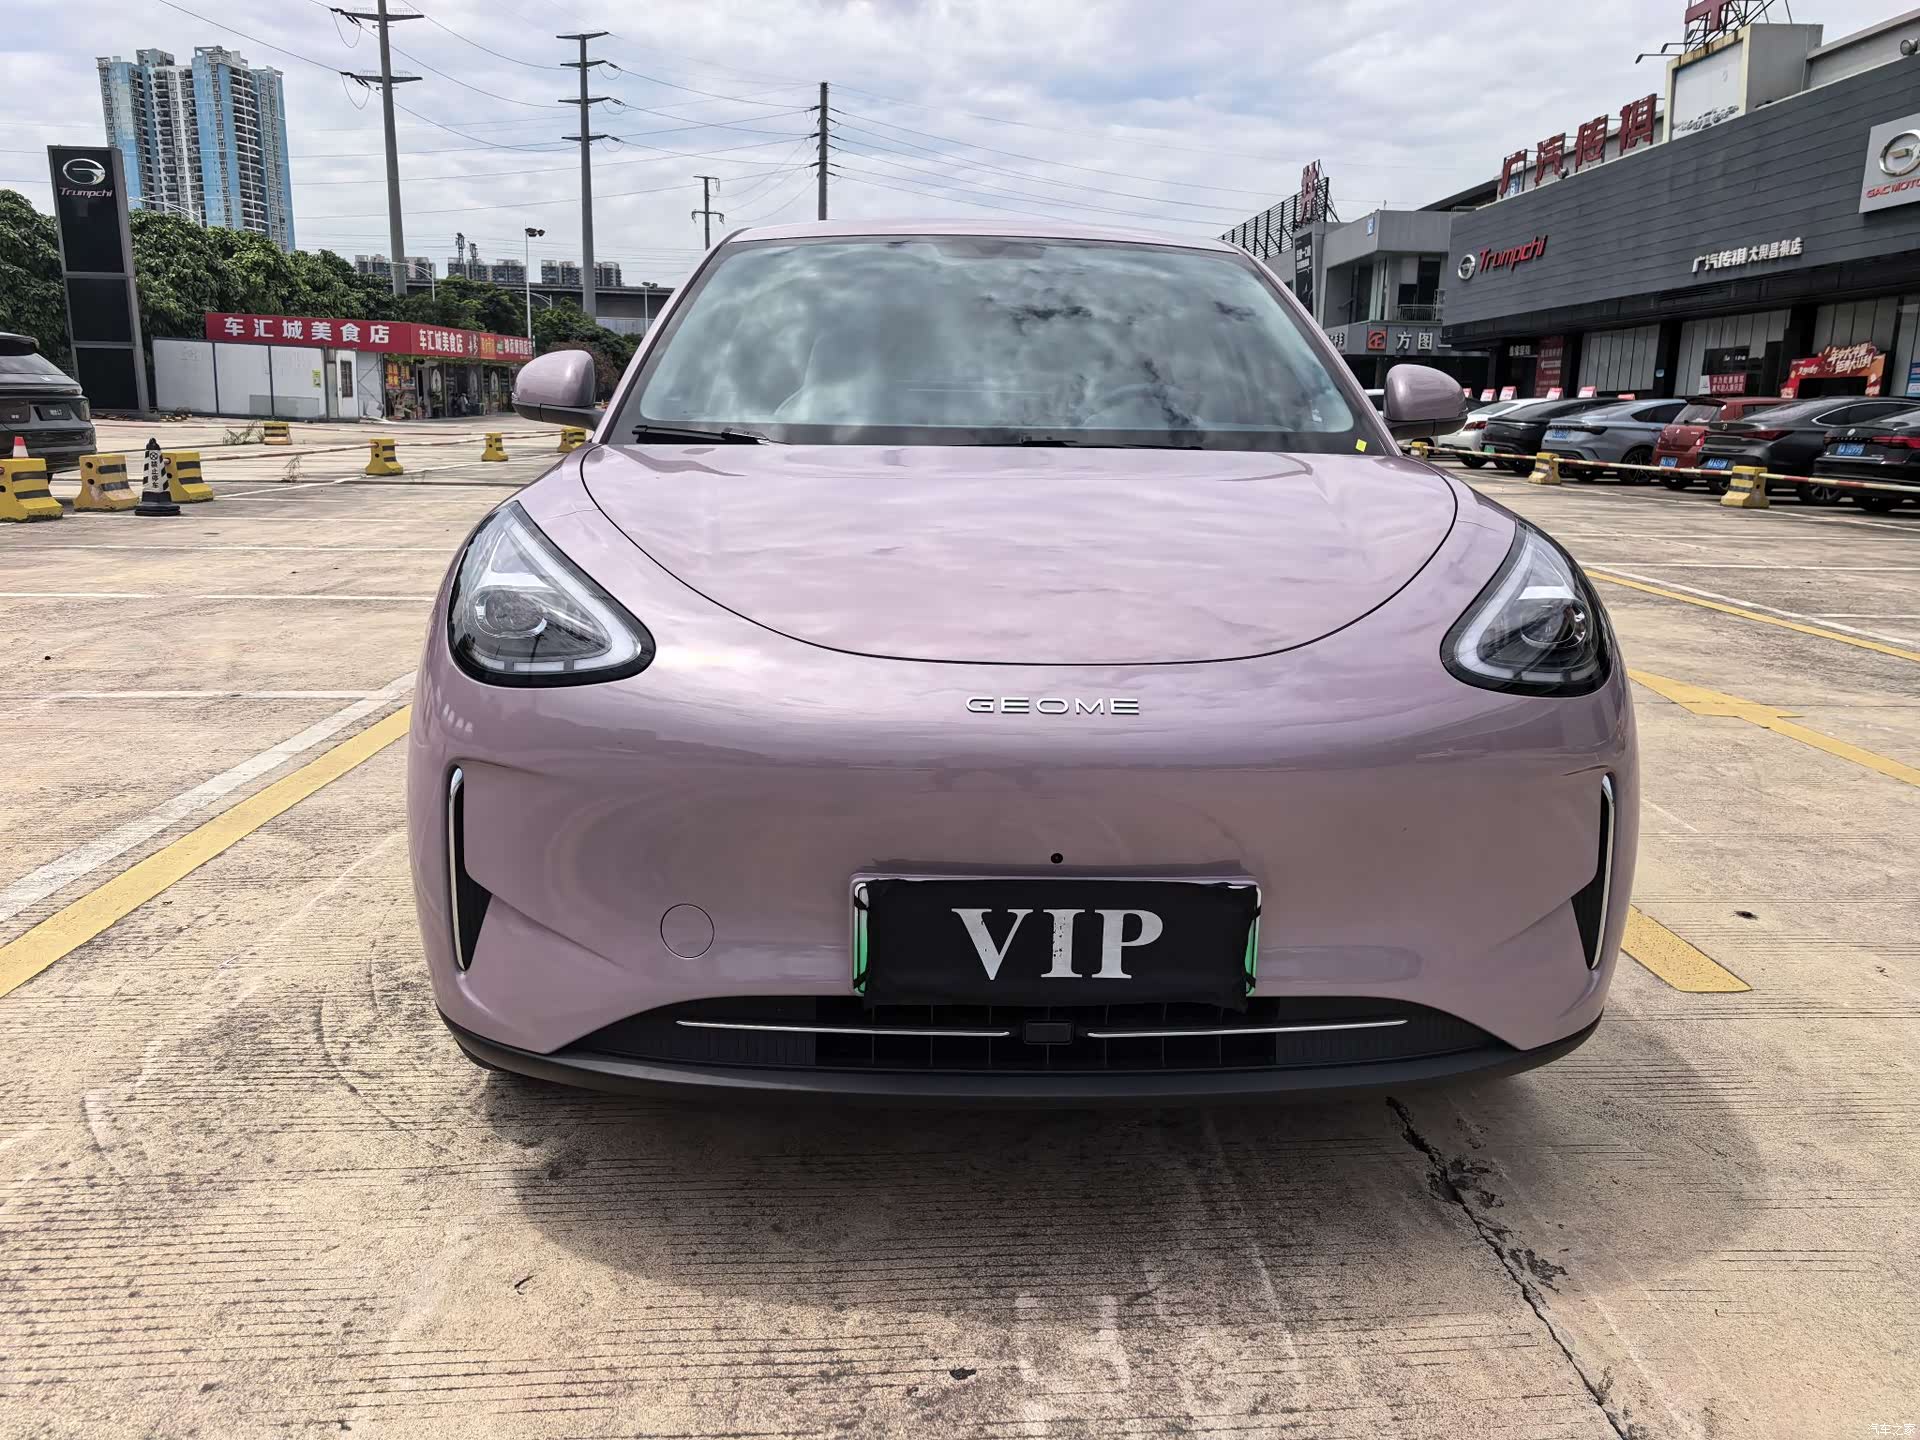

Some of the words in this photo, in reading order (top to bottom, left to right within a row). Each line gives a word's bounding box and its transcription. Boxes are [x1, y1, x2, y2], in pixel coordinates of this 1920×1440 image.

[60, 187, 113, 199] Trumpchi
[1866, 185, 1891, 198] GAC
[1479, 235, 1548, 272] Trumpchi
[1691, 247, 1747, 273] 广汽传祺
[224, 316, 390, 344] 车汇城美食店
[419, 328, 463, 353] 车汇城美食店
[150, 460, 159, 489] 禁止停车
[964, 696, 1140, 715] GEOME
[951, 908, 1163, 981] VIP
